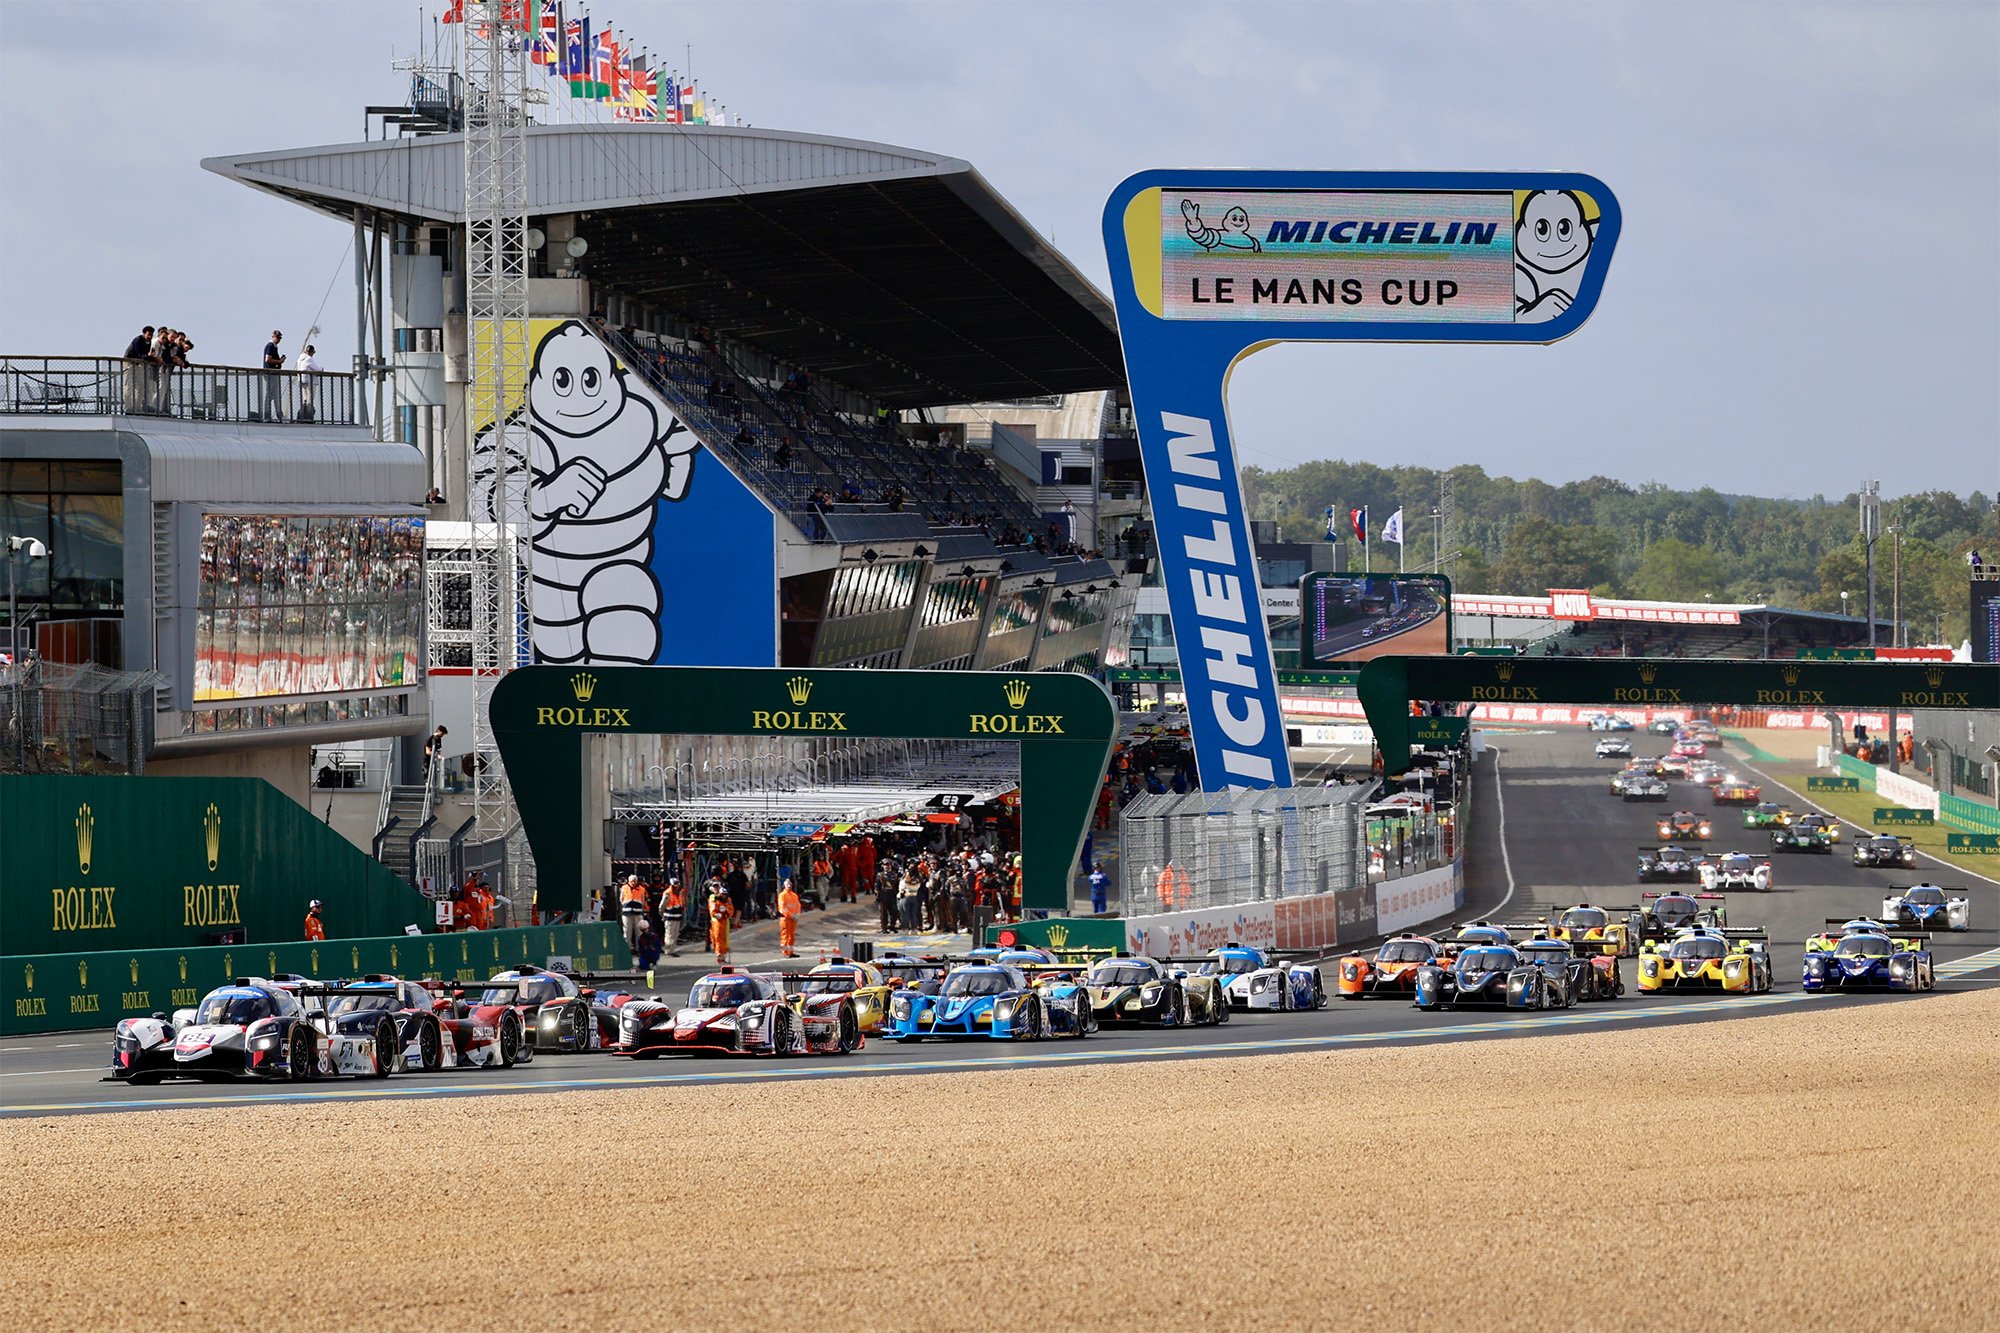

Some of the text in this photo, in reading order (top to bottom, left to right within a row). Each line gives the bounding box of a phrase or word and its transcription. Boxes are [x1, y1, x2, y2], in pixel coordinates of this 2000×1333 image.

[1265, 221, 1498, 245] MICHELIN
[1192, 278, 1459, 306] LE MANS CUP
[1160, 410, 1275, 791] ICHELIN
[1267, 598, 1294, 607] Center
[1553, 594, 1591, 616] MOTUL
[1472, 687, 1538, 700] ROLEX
[1615, 688, 1681, 702] ROLEX
[1757, 690, 1825, 704] ROLEX
[1900, 692, 1969, 705] ROLEX
[536, 706, 631, 727] ROLEX
[752, 710, 847, 731] ROLEX
[969, 714, 1065, 734] ROLEX
[1766, 712, 1804, 728] MOTUL
[1417, 731, 1450, 739] ROLEX
[1950, 846, 1982, 855] ROLEX
[52, 887, 116, 932] ROLEX
[183, 884, 241, 927] ROLEX
[70, 994, 100, 1013] ROLEX
[122, 991, 151, 1009] ROLEX
[172, 988, 197, 1006] ROLEX
[16, 998, 47, 1017] ROLEX
[184, 1032, 209, 1043] 85
[317, 1050, 328, 1073] 85
